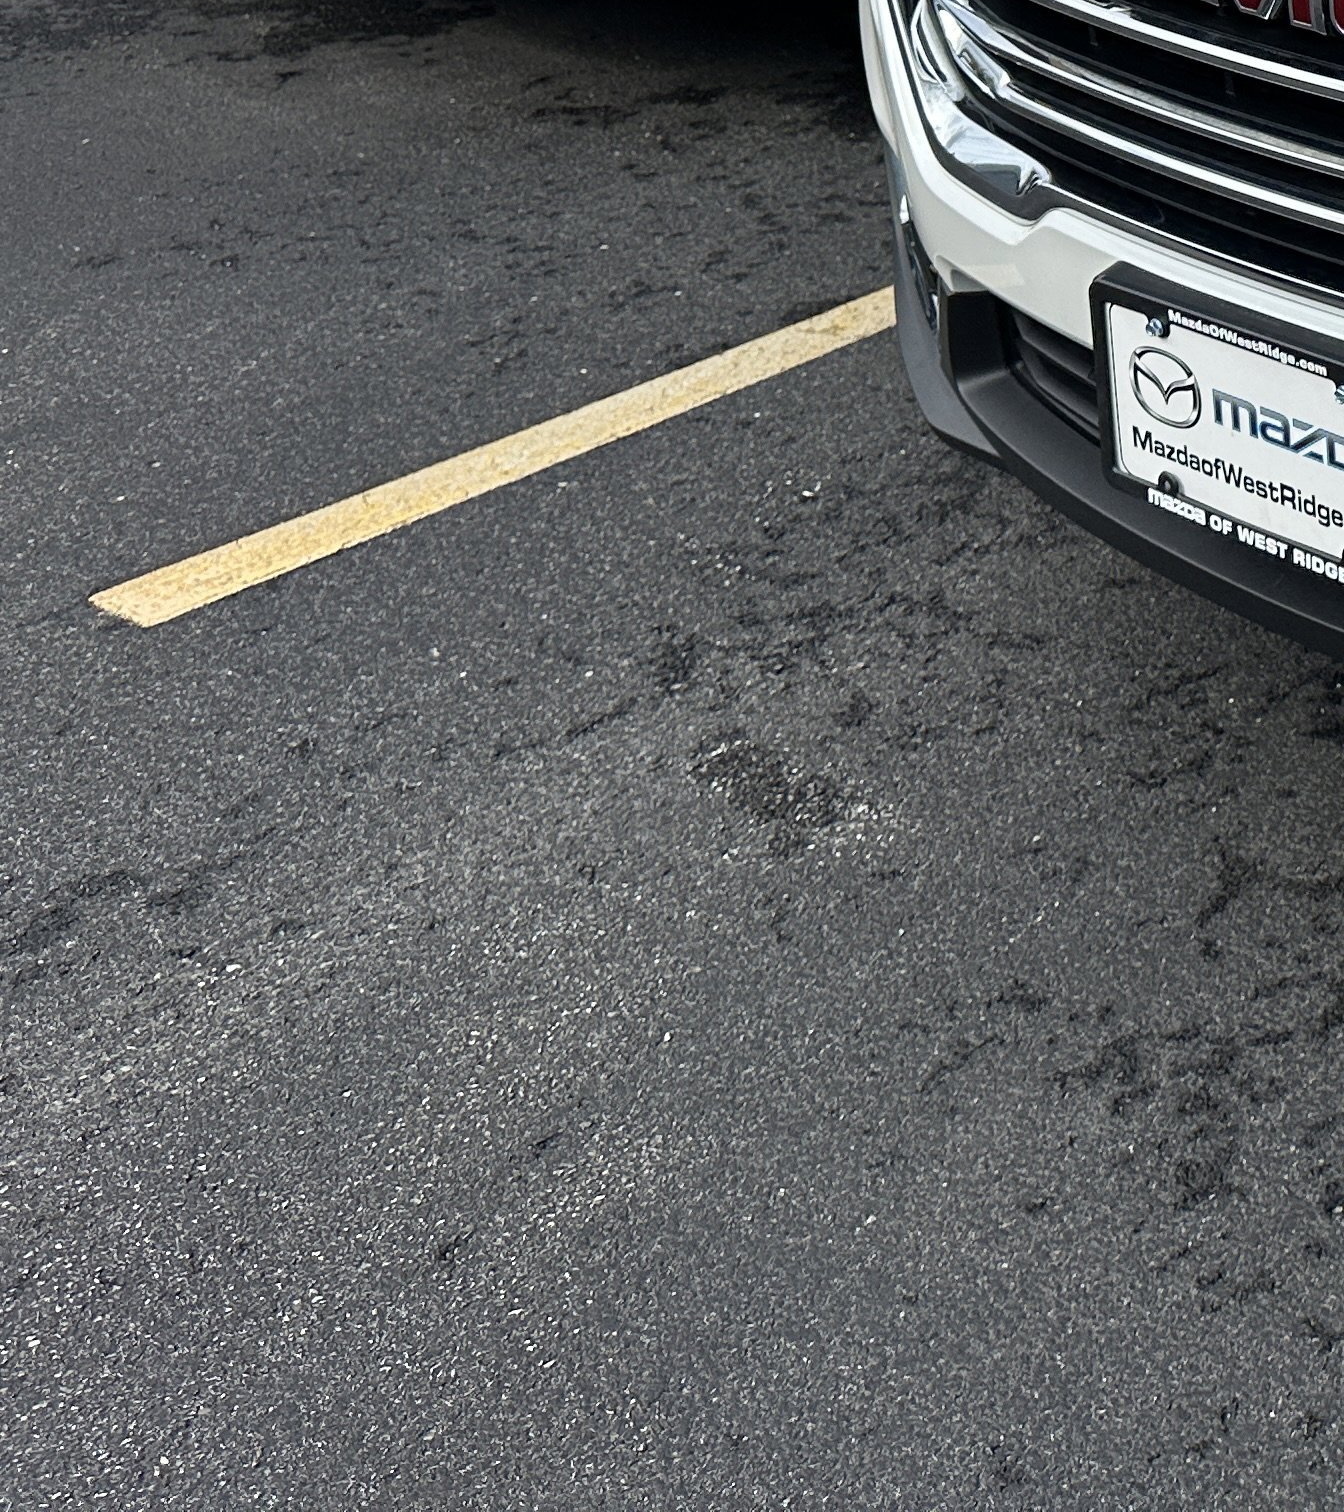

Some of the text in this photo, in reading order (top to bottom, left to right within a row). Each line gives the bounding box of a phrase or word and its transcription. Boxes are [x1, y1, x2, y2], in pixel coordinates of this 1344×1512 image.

[1168, 309, 1328, 377] MazdaOfWestRidge.com
[1209, 517, 1233, 536] OF
[1237, 524, 1288, 561] WEST
